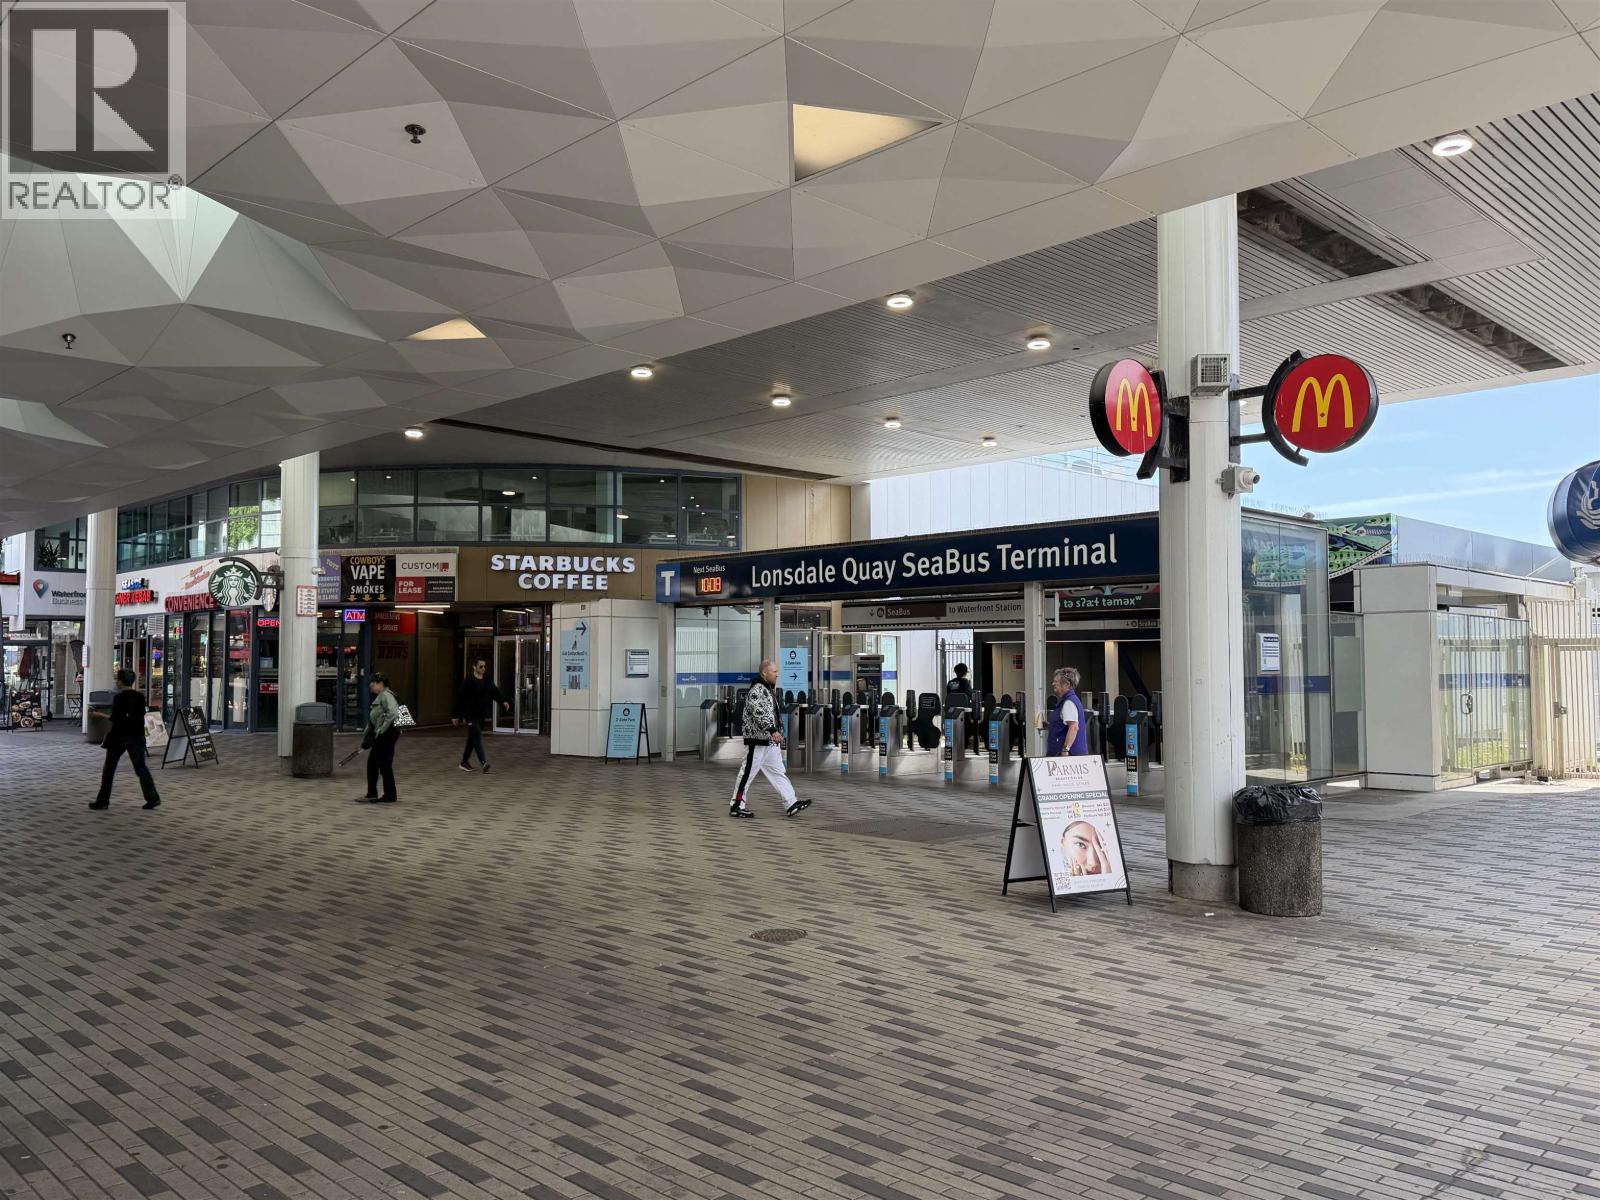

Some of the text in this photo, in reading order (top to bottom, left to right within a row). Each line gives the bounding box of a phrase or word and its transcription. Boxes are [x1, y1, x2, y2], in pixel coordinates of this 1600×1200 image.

[350, 556, 386, 565] COWBOYS
[401, 562, 440, 570] CUSTOM
[490, 553, 636, 573] STARBUCKS
[751, 533, 1118, 588] Lonsdale Quay SeaBus Terminal
[350, 564, 386, 580] VAPE
[705, 564, 726, 573] SeaBus
[518, 573, 609, 591] COFFEE
[660, 570, 675, 596] T
[350, 585, 385, 594] SMOKES
[887, 600, 1022, 617] SeaBus to Waterfront Station
[345, 612, 365, 620] ATM
[257, 619, 281, 627] OPEN
[1046, 760, 1089, 777] PARMIS
[1059, 793, 1085, 801] OPENING
